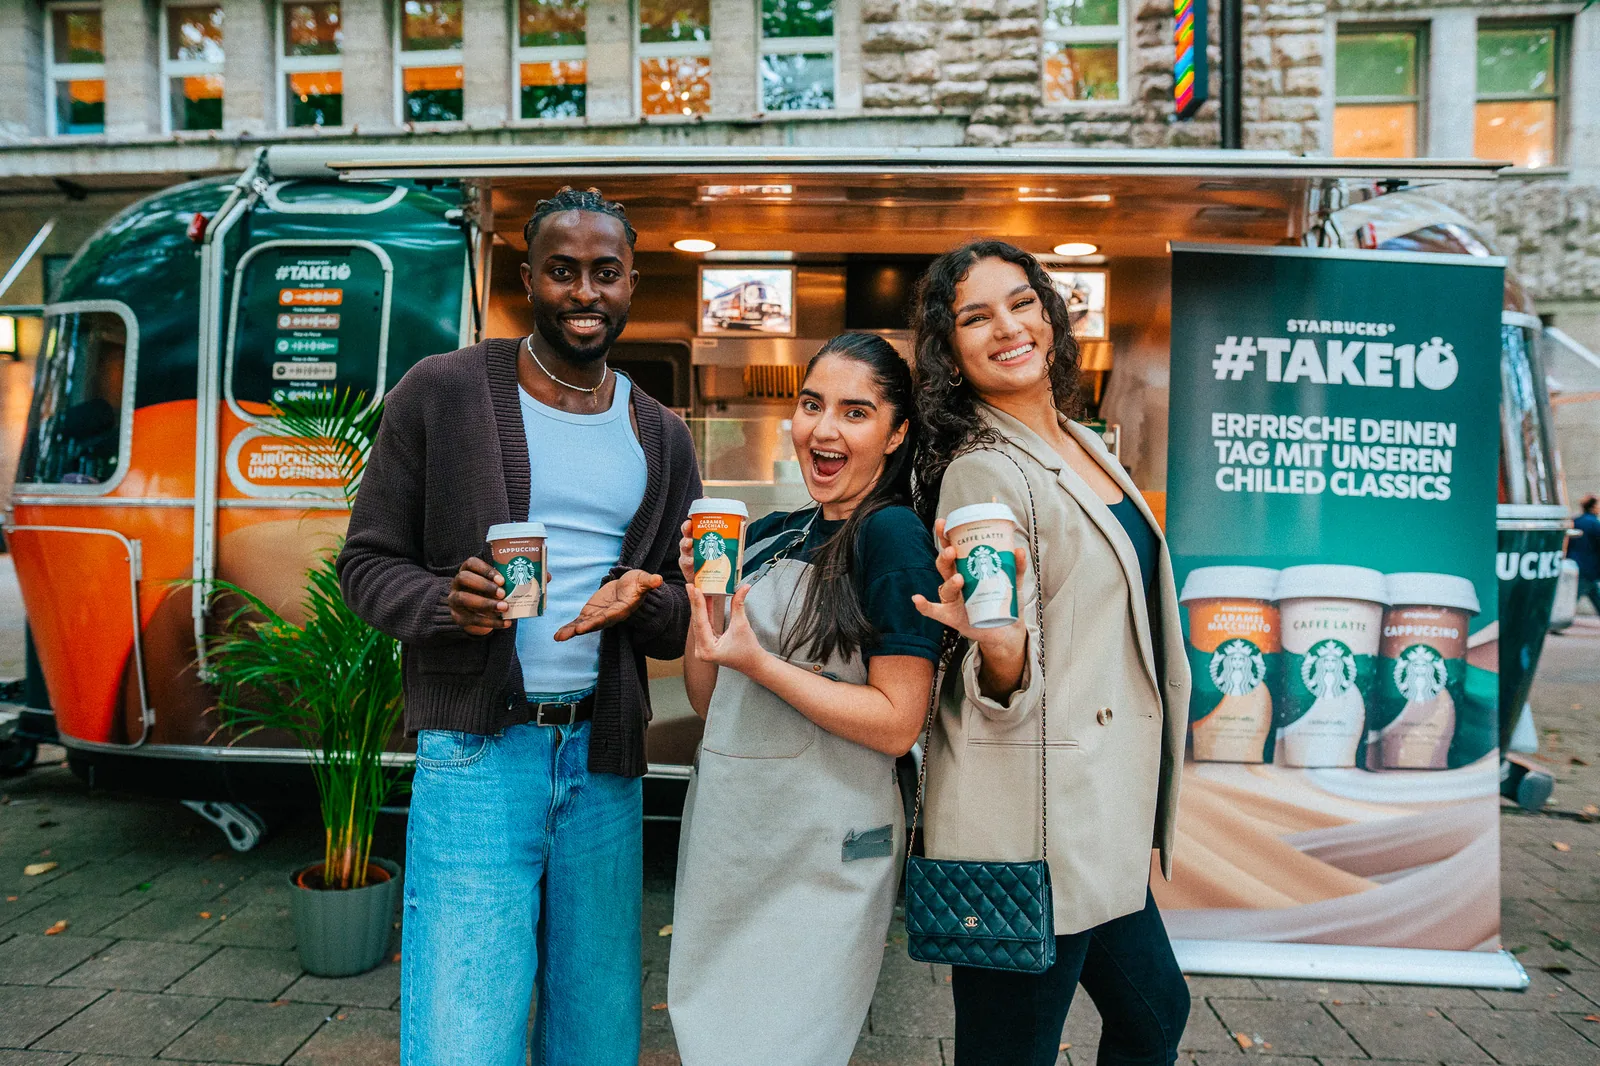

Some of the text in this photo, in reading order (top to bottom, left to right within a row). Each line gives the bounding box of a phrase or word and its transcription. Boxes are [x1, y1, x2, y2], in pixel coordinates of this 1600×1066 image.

[275, 263, 351, 280] #TAKE10
[1212, 335, 1459, 391] #TAKE10
[1211, 412, 1457, 447] ERFRISCHE DEINEN
[1214, 440, 1453, 474] TAG MIT UNSEREN
[247, 465, 277, 479] UND
[1215, 467, 1451, 501] CHILLED CLASSICS
[498, 546, 540, 555] CAPPUCCINO
[1213, 613, 1265, 625] CARAMEL
[1333, 620, 1367, 632] LATTE
[1207, 621, 1271, 633] MACCHIATO
[1383, 625, 1459, 639] CAPPUCCINO
